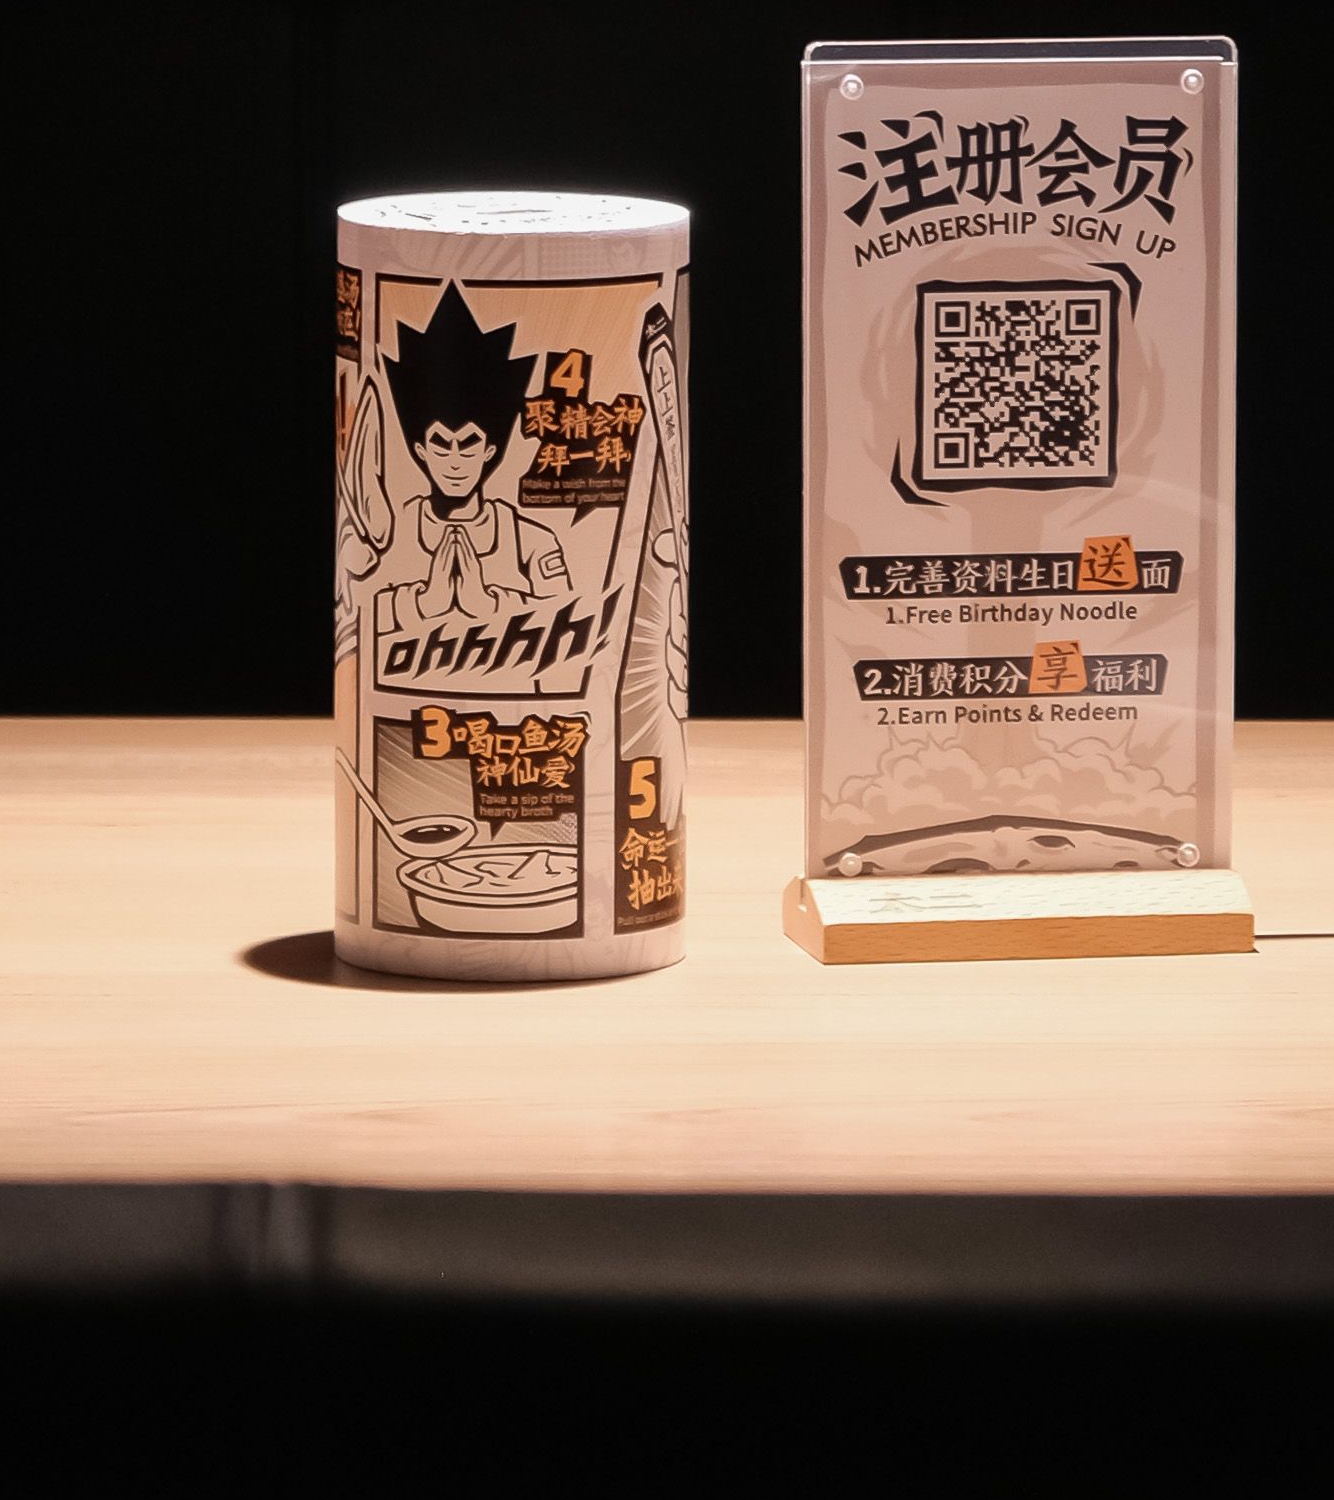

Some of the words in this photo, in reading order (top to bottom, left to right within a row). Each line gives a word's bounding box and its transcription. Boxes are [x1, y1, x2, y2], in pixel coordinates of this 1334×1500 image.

[837, 112, 1190, 227] 注册会员
[855, 211, 1037, 267] MEMBERSHIP
[1050, 213, 1122, 246] SIGN
[1136, 230, 1176, 261] UP
[551, 352, 584, 397] 4
[525, 398, 643, 440] 聚精会神
[538, 436, 629, 477] 拜一拜
[853, 541, 1172, 596] 1.完善资料生日送面
[383, 585, 624, 680] ohhhh!
[886, 605, 953, 625] 1.Free
[959, 602, 1054, 627] Birthday
[1060, 601, 1138, 621] Noodle
[864, 645, 1158, 696] 2.消费积分享福利
[421, 707, 451, 757] 3
[877, 706, 947, 726] 2.Earn
[954, 705, 1022, 725] Points
[1027, 704, 1044, 722] &
[1050, 702, 1138, 722] Redeem
[453, 718, 585, 758] 喝口鱼汤
[480, 794, 506, 804] Take
[511, 796, 518, 804] a
[522, 794, 538, 807] sip
[540, 793, 553, 804] of
[554, 794, 575, 804] the
[480, 806, 518, 819] hearty
[521, 805, 553, 817] broth
[629, 760, 656, 819] 5
